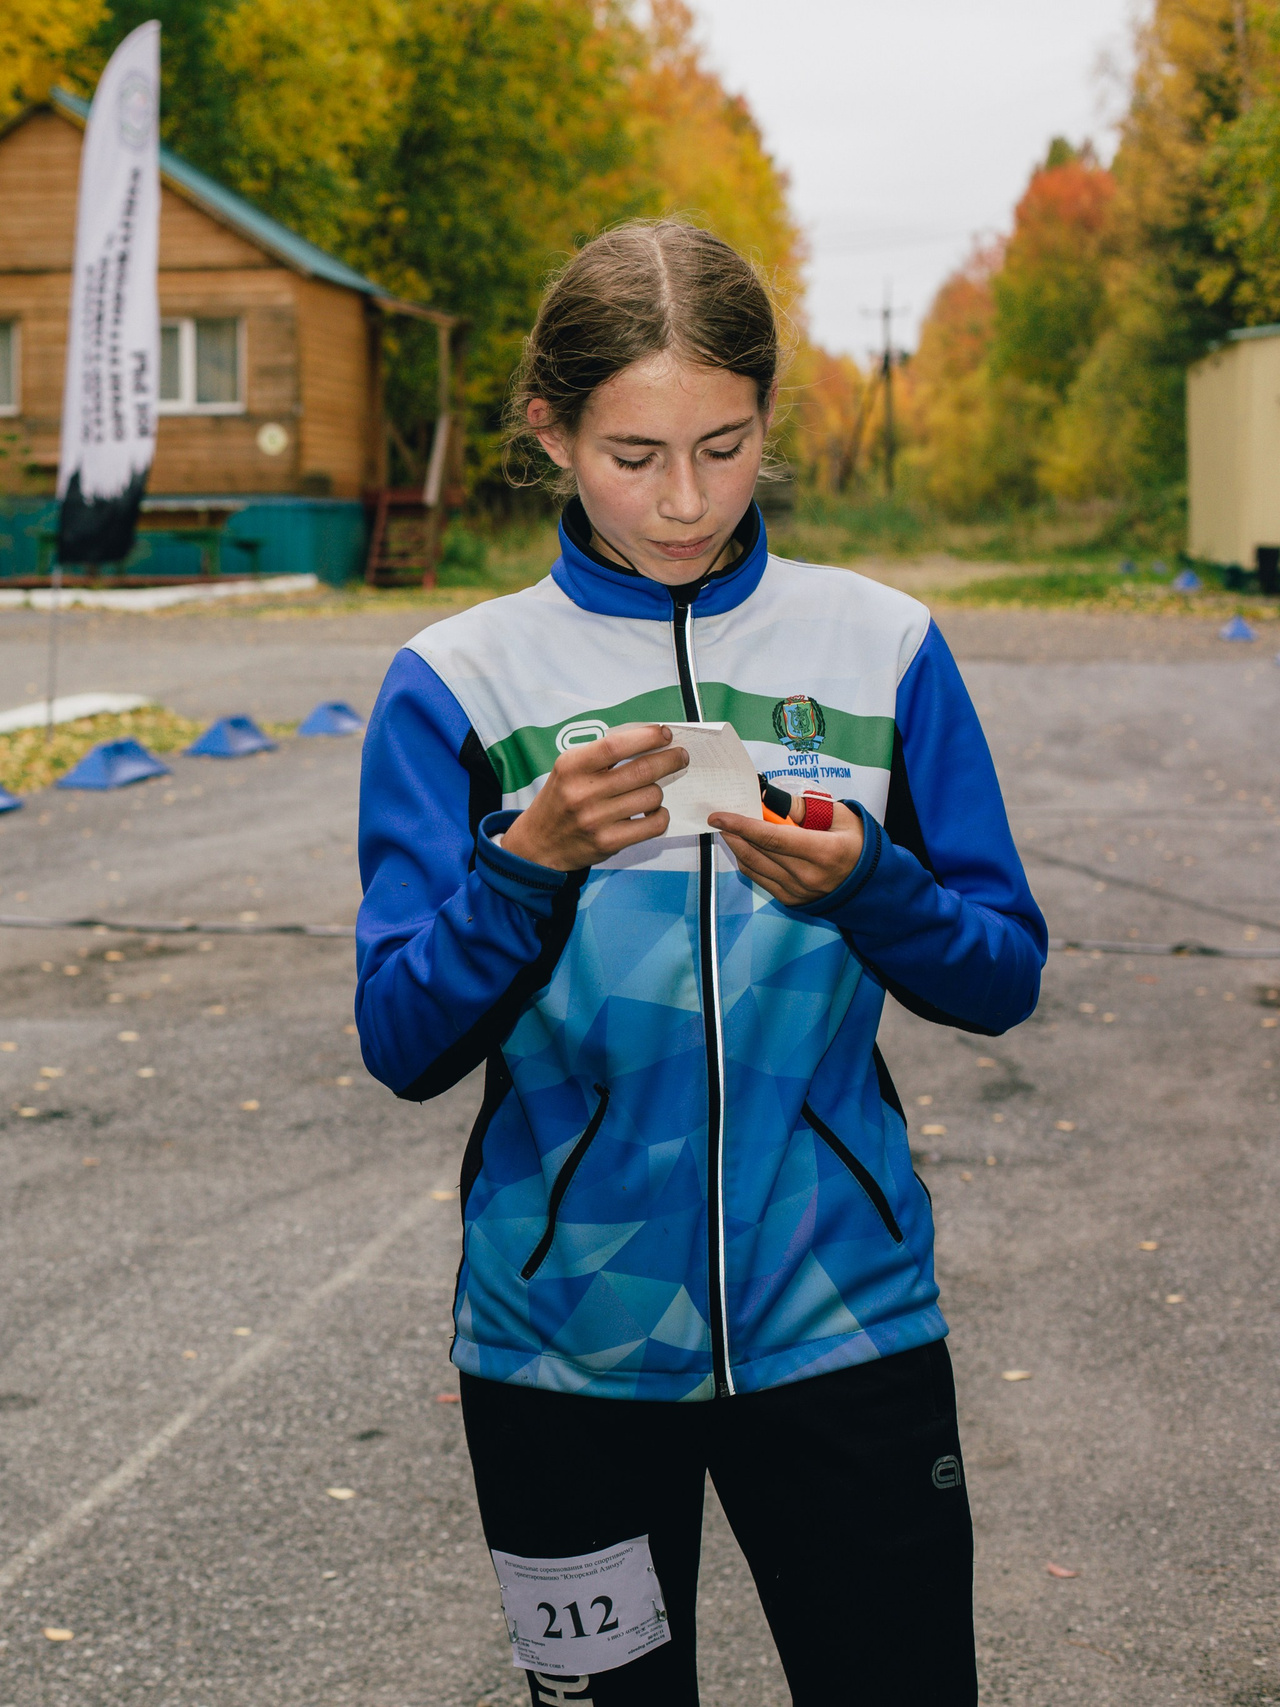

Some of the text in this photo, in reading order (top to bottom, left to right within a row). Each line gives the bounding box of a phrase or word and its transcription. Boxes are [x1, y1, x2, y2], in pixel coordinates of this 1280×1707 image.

[787, 754, 819, 766] СУРГУТ
[762, 765, 851, 780] ПОРТИВНЫЙ ТУРИЗМ
[539, 1564, 583, 1574] соревнования
[584, 1561, 593, 1569] по
[593, 1545, 634, 1566] спортивному
[560, 1568, 598, 1581] "Югорский
[599, 1557, 626, 1573] Азимут"
[536, 1595, 619, 1639] 212
